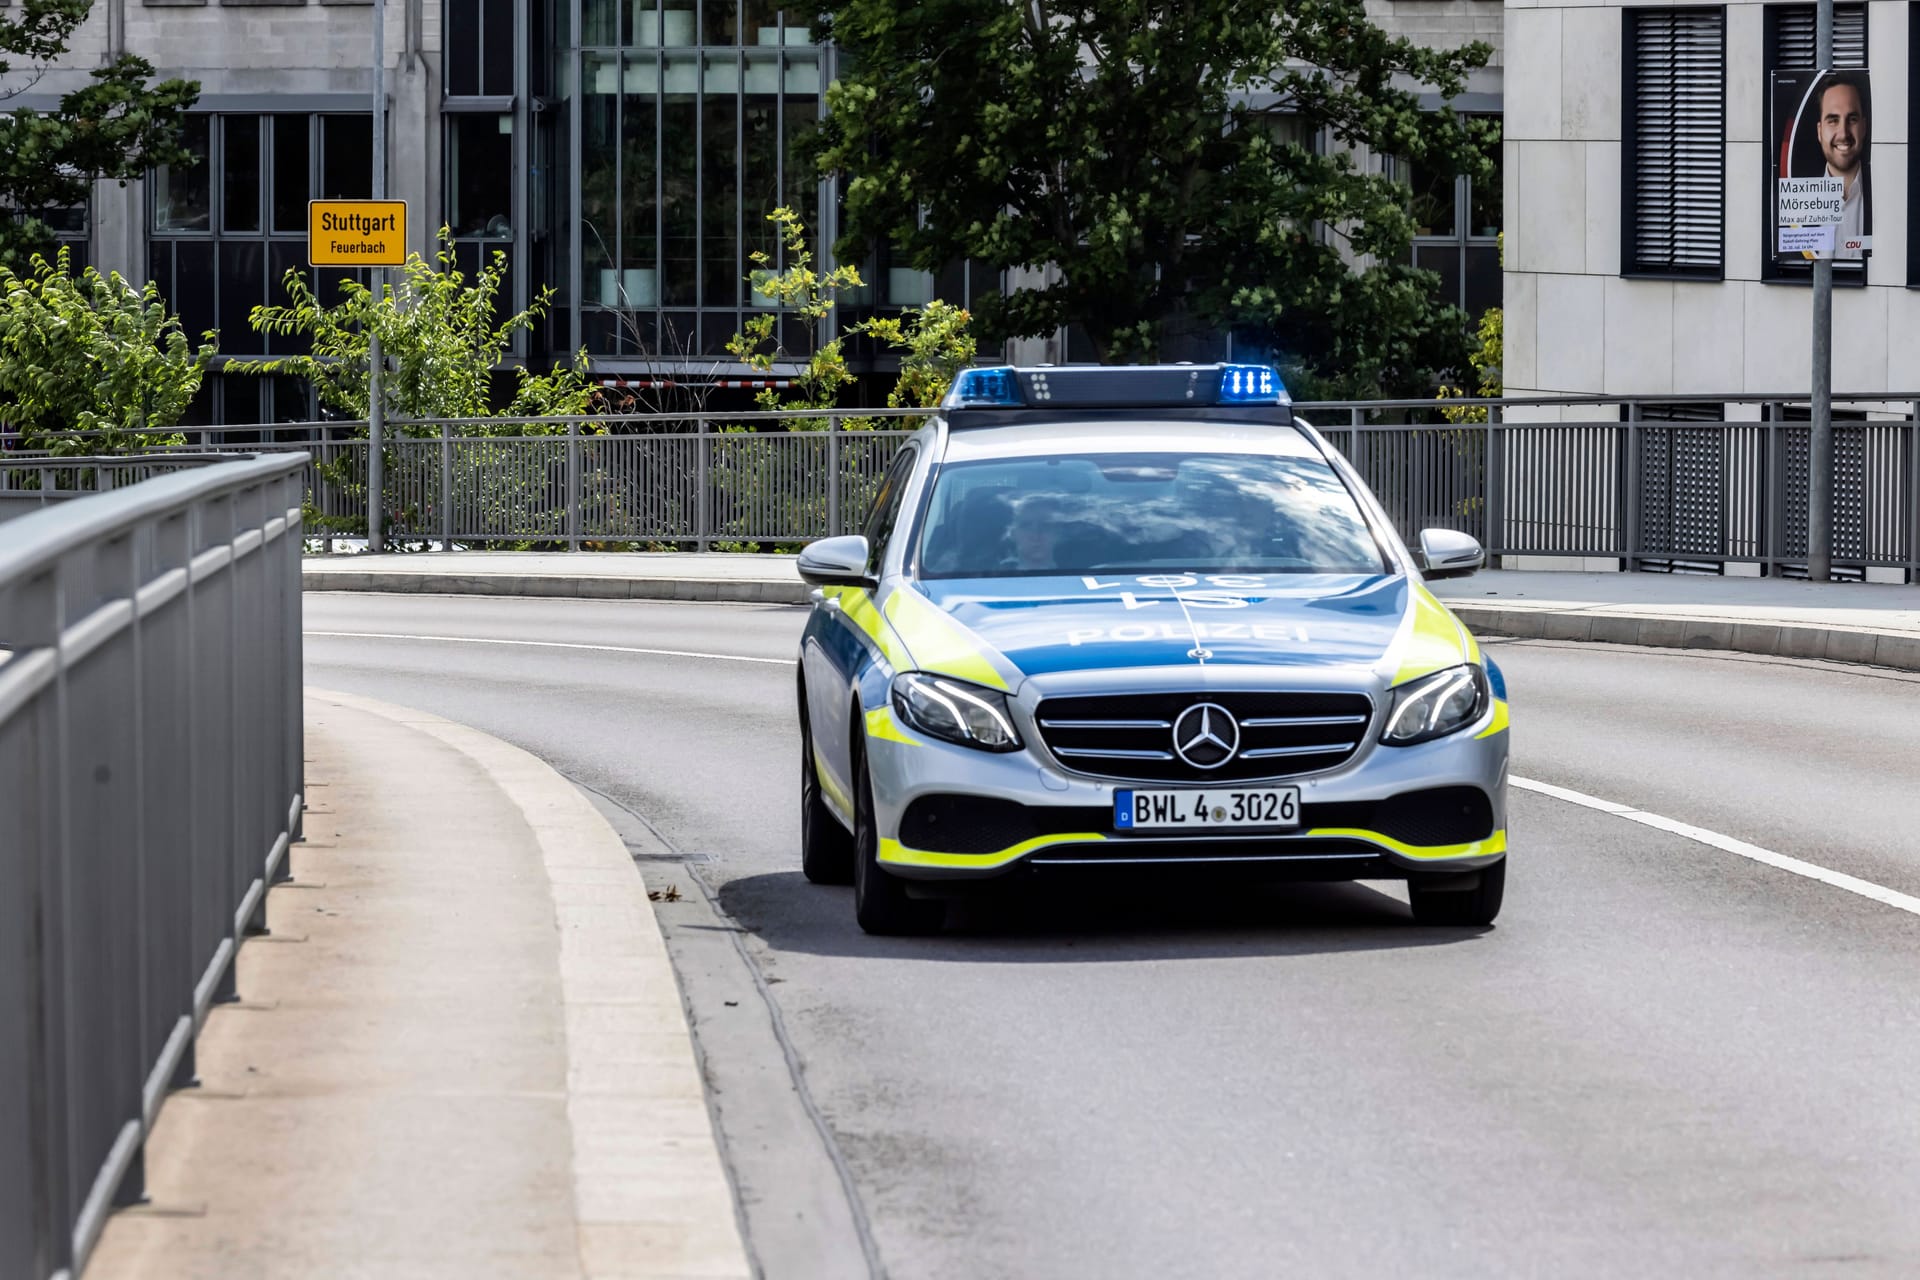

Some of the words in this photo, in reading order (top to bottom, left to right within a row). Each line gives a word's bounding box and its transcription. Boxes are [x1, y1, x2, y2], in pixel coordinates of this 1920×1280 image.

[1780, 180, 1843, 193] Maximilian
[1780, 197, 1840, 213] Mörseburg
[322, 212, 395, 236] Stuttgart
[1780, 215, 1795, 223] Max
[1796, 214, 1807, 223] auf
[331, 241, 385, 253] Feuerbach
[1845, 241, 1862, 249] CDU
[1067, 622, 1309, 646] POLIZEI
[1121, 812, 1128, 821] D
[1135, 794, 1186, 823] BWL
[1194, 794, 1209, 822] 4
[1230, 792, 1295, 822] 3026
